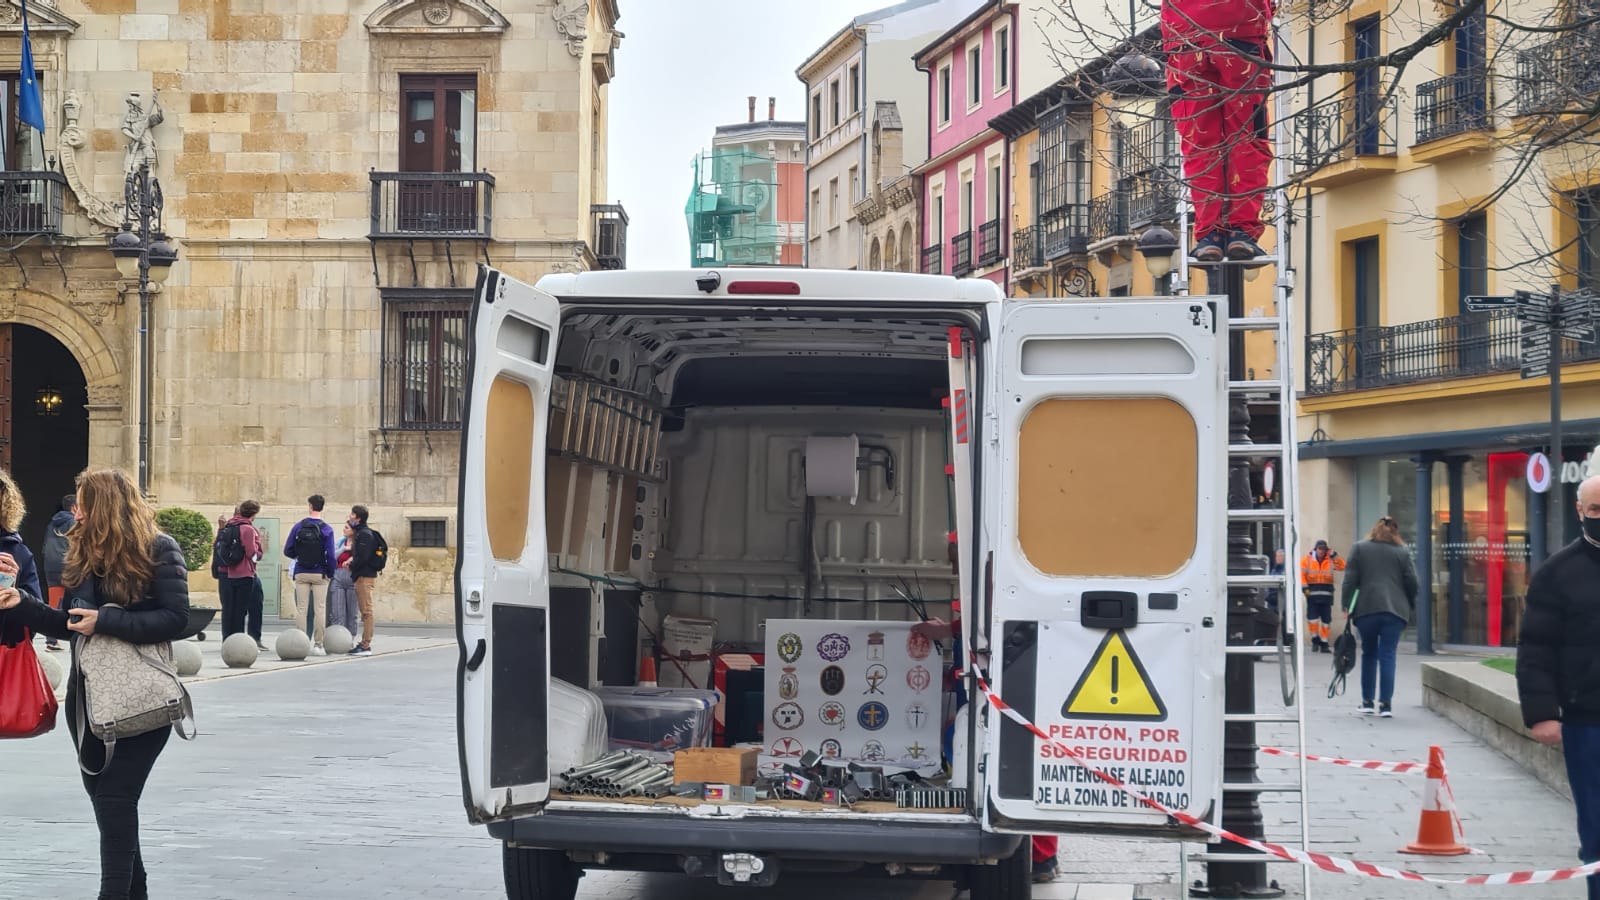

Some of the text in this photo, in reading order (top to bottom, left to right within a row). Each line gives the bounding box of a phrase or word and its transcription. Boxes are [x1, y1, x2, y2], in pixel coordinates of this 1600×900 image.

[1049, 723, 1180, 744] PEATÓN, POR
[1040, 744, 1187, 763] SU SEGURIDAD
[1128, 767, 1185, 787] ALEJADO
[1056, 787, 1071, 805] LA
[1074, 788, 1109, 807] ZONA
[1112, 789, 1128, 807] DE
